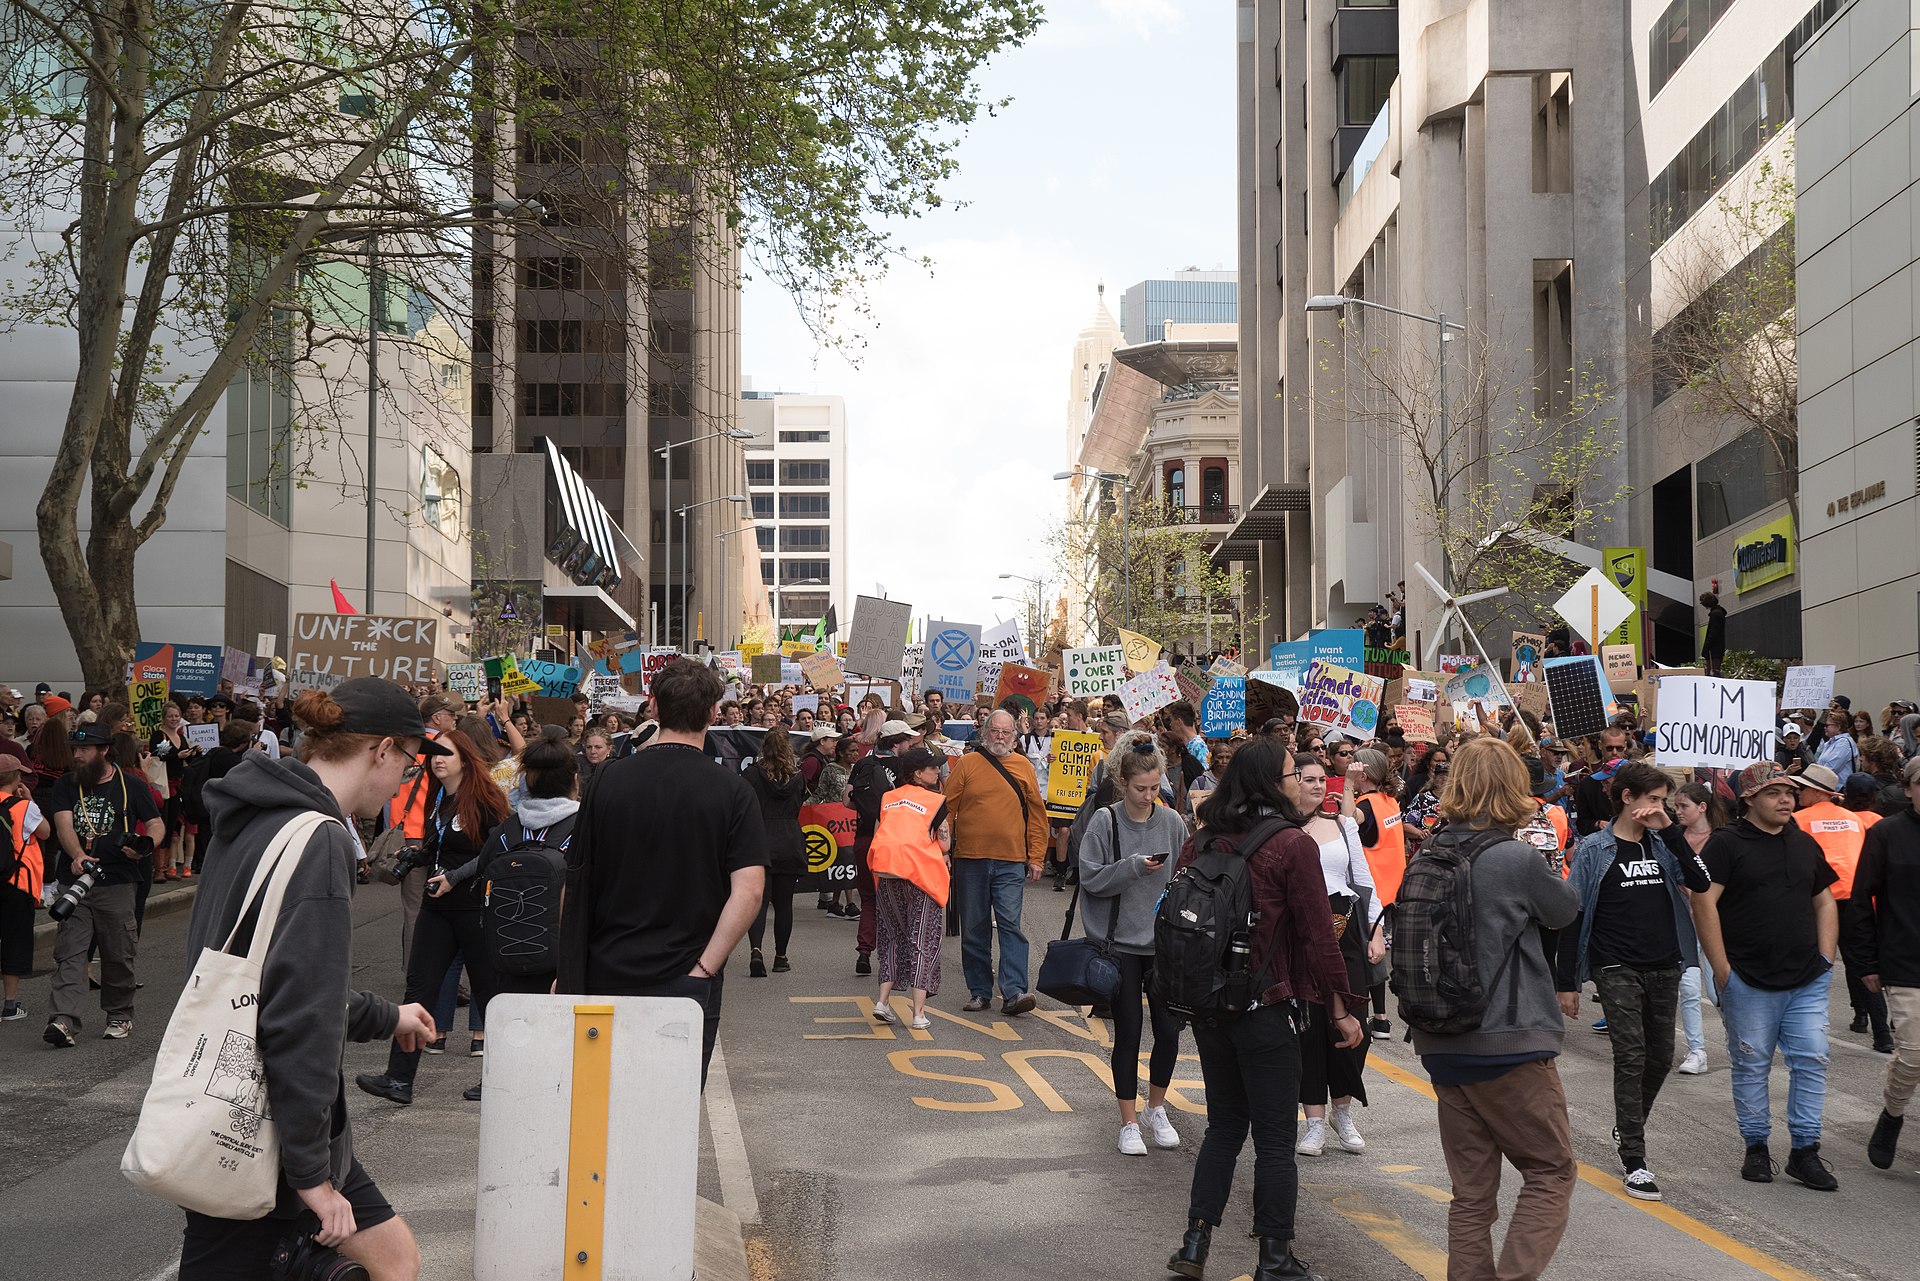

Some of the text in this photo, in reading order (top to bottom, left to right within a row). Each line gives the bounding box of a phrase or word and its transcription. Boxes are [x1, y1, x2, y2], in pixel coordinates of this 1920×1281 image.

[1837, 495, 1849, 514] THE
[1850, 480, 1886, 509] ESPLANADE
[856, 597, 910, 620] NO JOBS
[856, 616, 899, 638] ON A
[351, 641, 378, 652] THE
[849, 633, 903, 663] DEAD
[1003, 647, 1019, 658] OIL
[1319, 646, 1343, 654] want
[178, 651, 213, 661] Less gas
[1072, 649, 1123, 665] PLANET
[1312, 655, 1358, 664] action on
[1364, 647, 1411, 665] TUDYING
[1440, 654, 1476, 669] Protect
[142, 665, 167, 673] Clean
[176, 659, 215, 669] pollution,
[294, 652, 432, 683] FUTURE
[525, 660, 556, 676] NO
[847, 657, 899, 678] PLANET
[1217, 656, 1235, 670] OUR
[1609, 661, 1619, 669] NO
[195, 667, 214, 675] clean
[290, 669, 316, 684] ACT
[449, 671, 475, 681] COAL
[508, 671, 518, 680] NO
[1084, 665, 1114, 678] OVER
[1183, 659, 1195, 669] IF
[1200, 670, 1213, 683] YOU
[1364, 662, 1402, 679] FUTUR
[1420, 671, 1444, 683] Save
[1797, 667, 1816, 676] ANIMAL
[466, 679, 475, 687] A
[938, 674, 964, 686] SPEAK
[1071, 677, 1126, 694] PROFIT
[1174, 672, 1201, 696] NOTHING
[1181, 667, 1210, 692] CHANGE
[1222, 678, 1244, 689] AINT
[1304, 661, 1362, 699] Climate
[136, 682, 161, 698] ONE
[450, 685, 479, 694] DIRTY
[945, 687, 971, 700] TRUTH
[1208, 689, 1246, 701] SPENDING
[1795, 688, 1830, 699] DESTROYING
[132, 698, 166, 714] EARTH
[1206, 700, 1223, 711] OUR
[1693, 681, 1745, 722] I'M
[1789, 698, 1820, 708] THE PLANET
[140, 711, 162, 726] ONE
[1207, 710, 1246, 721] BIRTHDAYS
[1204, 721, 1246, 733] SWIMMING
[1060, 740, 1100, 754] GLOBA
[1657, 721, 1774, 762] SCOMOPHOBIC
[1059, 752, 1091, 765] CLIMA
[1062, 764, 1089, 777] STRI
[1056, 789, 1083, 798] FRI SEPT
[899, 800, 924, 813] MARSHAL
[827, 864, 858, 881] res
[1618, 859, 1660, 878] VANS
[1620, 880, 1635, 888] OFF
[216, 1140, 234, 1151] LONELY
